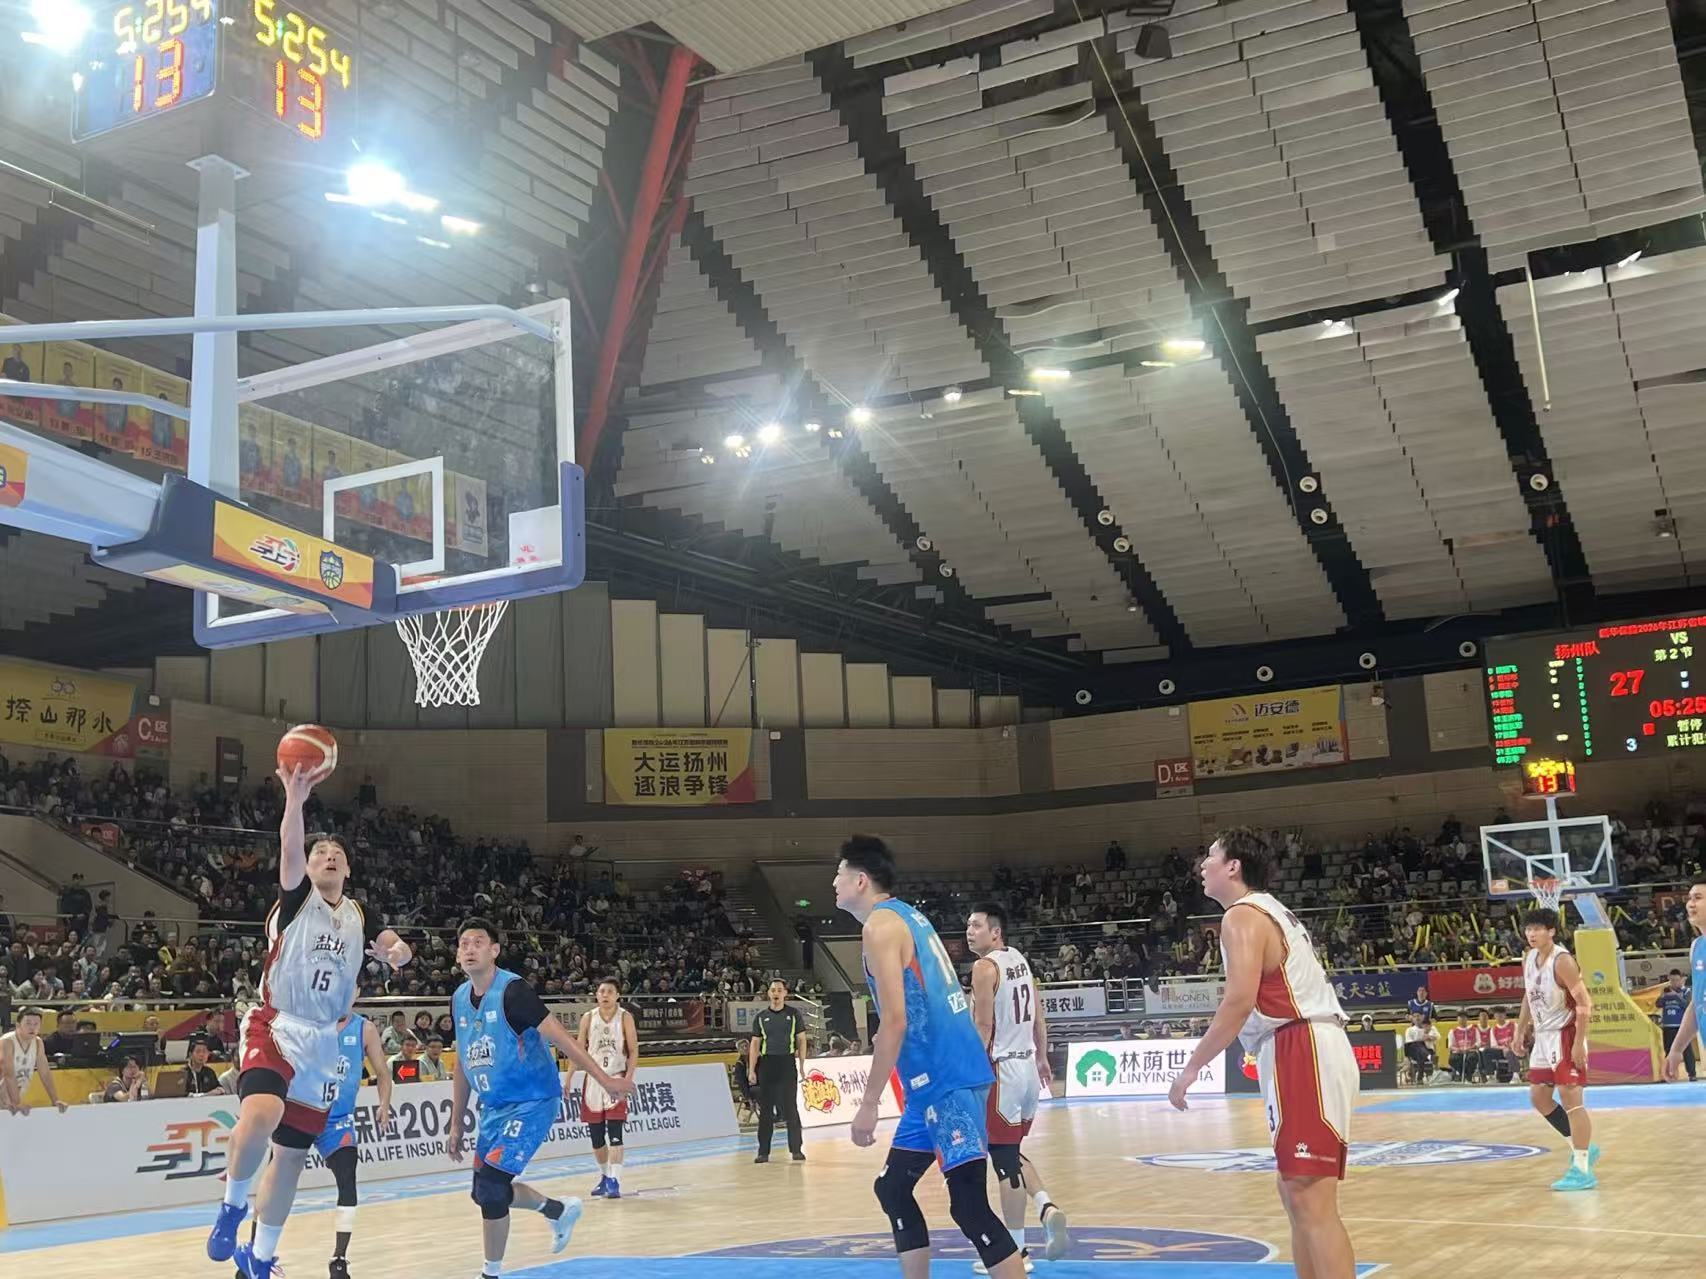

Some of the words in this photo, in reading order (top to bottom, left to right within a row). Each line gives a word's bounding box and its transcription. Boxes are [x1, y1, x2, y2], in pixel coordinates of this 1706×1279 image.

[133, 38, 184, 112] 13
[275, 59, 325, 140] 13
[1670, 631, 1689, 644] VS
[1554, 640, 1600, 659] 扬州队
[1610, 669, 1645, 696] 27
[1255, 700, 1300, 717] 迈安德
[1649, 696, 1706, 718] 05:25
[1626, 737, 1638, 752] 3
[1666, 732, 1706, 747] 累计犯
[634, 752, 728, 773] 大运扬州
[634, 775, 729, 797] 逐浪争锋
[311, 969, 332, 992] 15
[1012, 984, 1031, 1024] 12
[1120, 1050, 1210, 1072] 林荫世
[474, 1074, 490, 1092] 13
[1119, 1070, 1214, 1084] LINYINSIA
[377, 1144, 403, 1162] LIFE
[406, 1137, 477, 1159] INSURCE
[558, 1126, 591, 1141] BASKE
[624, 1119, 643, 1134] CITY
[647, 1116, 681, 1131] LEAGUE
[503, 1119, 523, 1138] 13
